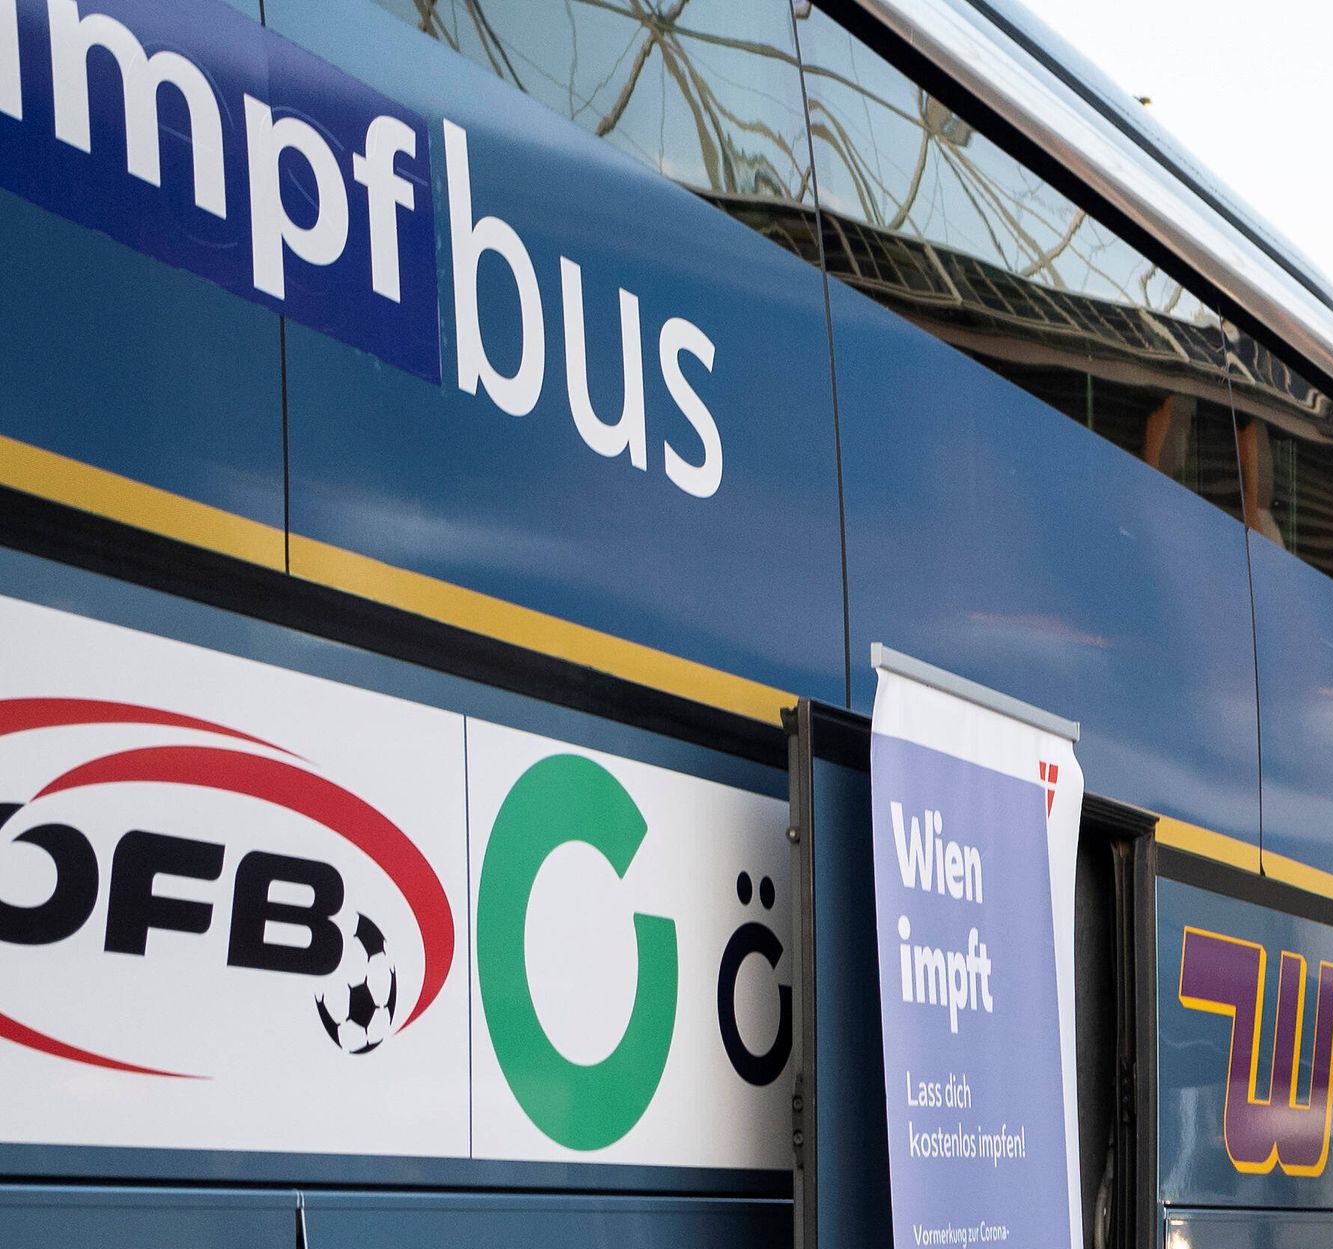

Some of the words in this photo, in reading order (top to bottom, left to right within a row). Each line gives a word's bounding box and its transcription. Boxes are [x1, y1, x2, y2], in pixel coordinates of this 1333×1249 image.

[889, 801, 984, 904] Wien
[898, 915, 994, 1034] impft
[906, 1070, 943, 1107] Lass
[945, 1072, 972, 1109] dich
[908, 1120, 977, 1158] kostenlos
[978, 1123, 1026, 1169] impfen!
[913, 1222, 967, 1249] Vormerkung
[968, 1227, 979, 1243] zur
[980, 1220, 1010, 1242] Corona-
